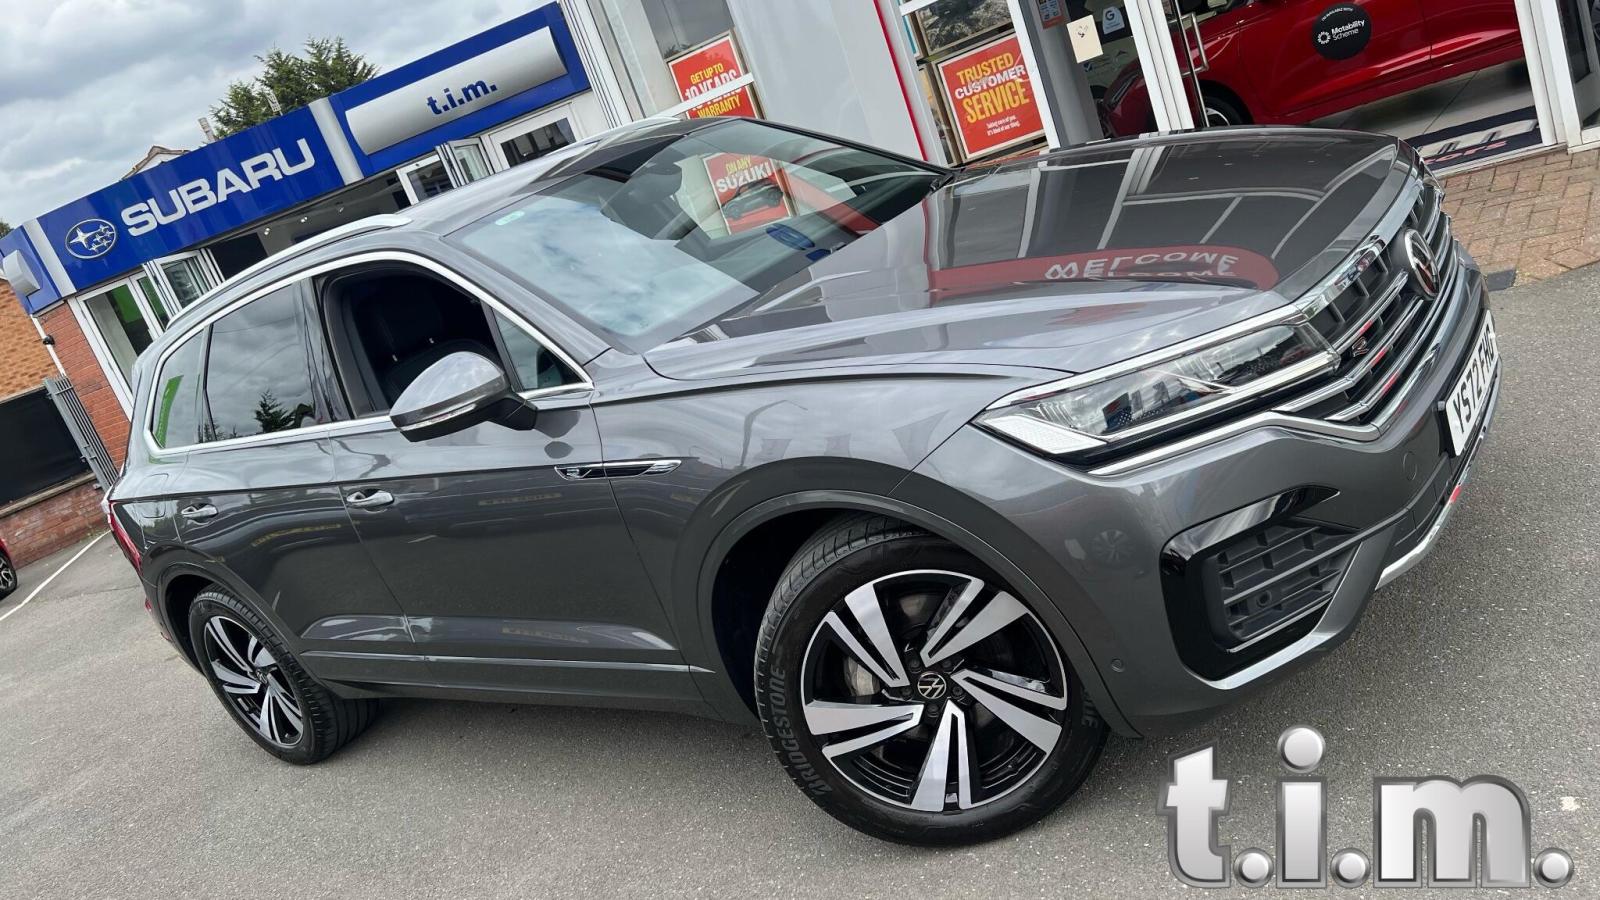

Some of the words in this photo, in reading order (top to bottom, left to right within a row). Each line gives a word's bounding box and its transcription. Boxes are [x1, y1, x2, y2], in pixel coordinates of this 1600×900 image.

[1331, 20, 1364, 34] Motability
[1332, 29, 1358, 40] Scheme
[690, 71, 704, 84] GET
[703, 66, 714, 78] UP
[713, 63, 724, 74] TO
[955, 65, 1026, 99] CUSTOMER
[956, 52, 1014, 85] TRUSTED
[426, 77, 498, 115] t.i.m.
[697, 95, 740, 118] WARRANTY
[962, 80, 1029, 123] SERVICE
[121, 138, 315, 237] SUBARU
[716, 162, 771, 192] SUZUKI
[1453, 358, 1482, 434] YS72
[769, 664, 833, 796] BRIDGESTONE
